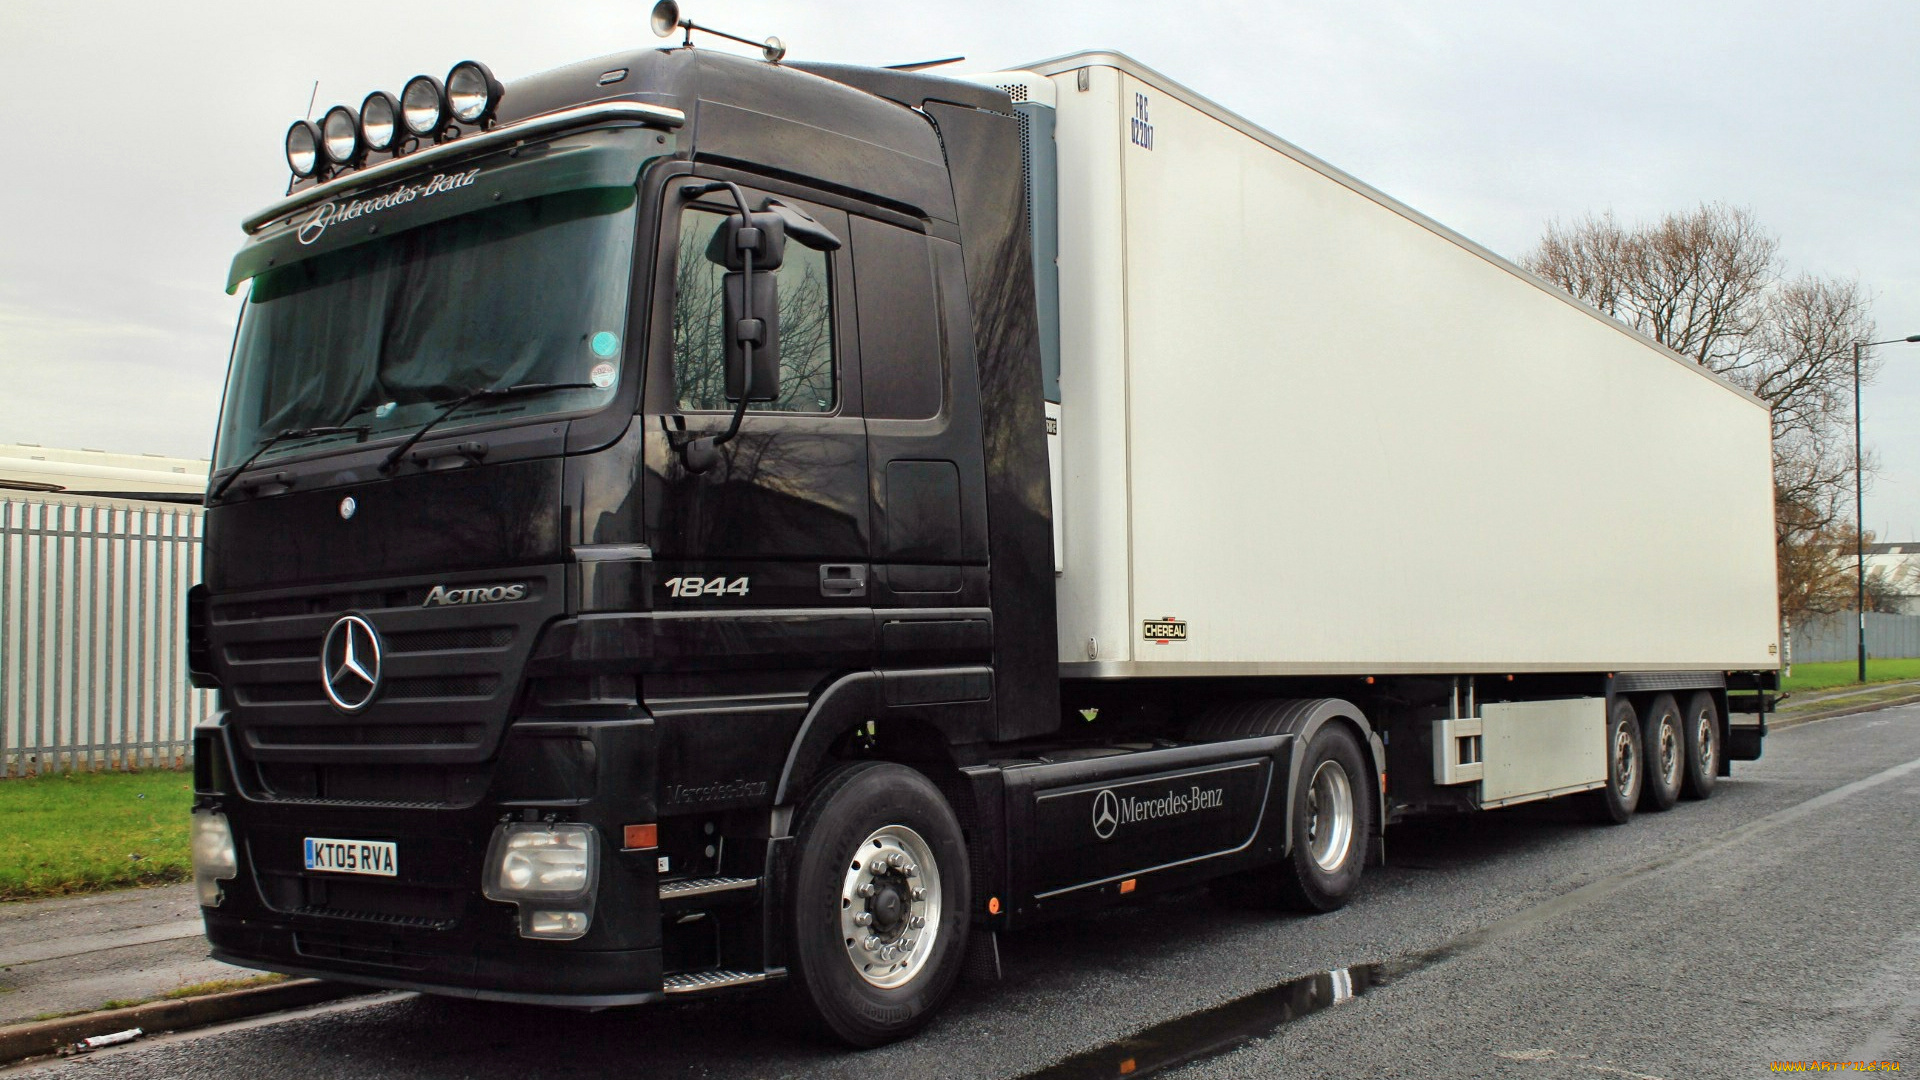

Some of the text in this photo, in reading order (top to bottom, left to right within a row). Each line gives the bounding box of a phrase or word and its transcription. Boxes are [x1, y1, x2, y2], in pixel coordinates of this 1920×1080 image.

[1135, 92, 1149, 122] FRC
[330, 168, 481, 226] Mercedes-Benz
[664, 577, 750, 597] 1844
[1145, 624, 1186, 637] CHEREAU
[1120, 786, 1223, 824] Mercedes-Benz
[314, 843, 394, 872] KT05 RVA
